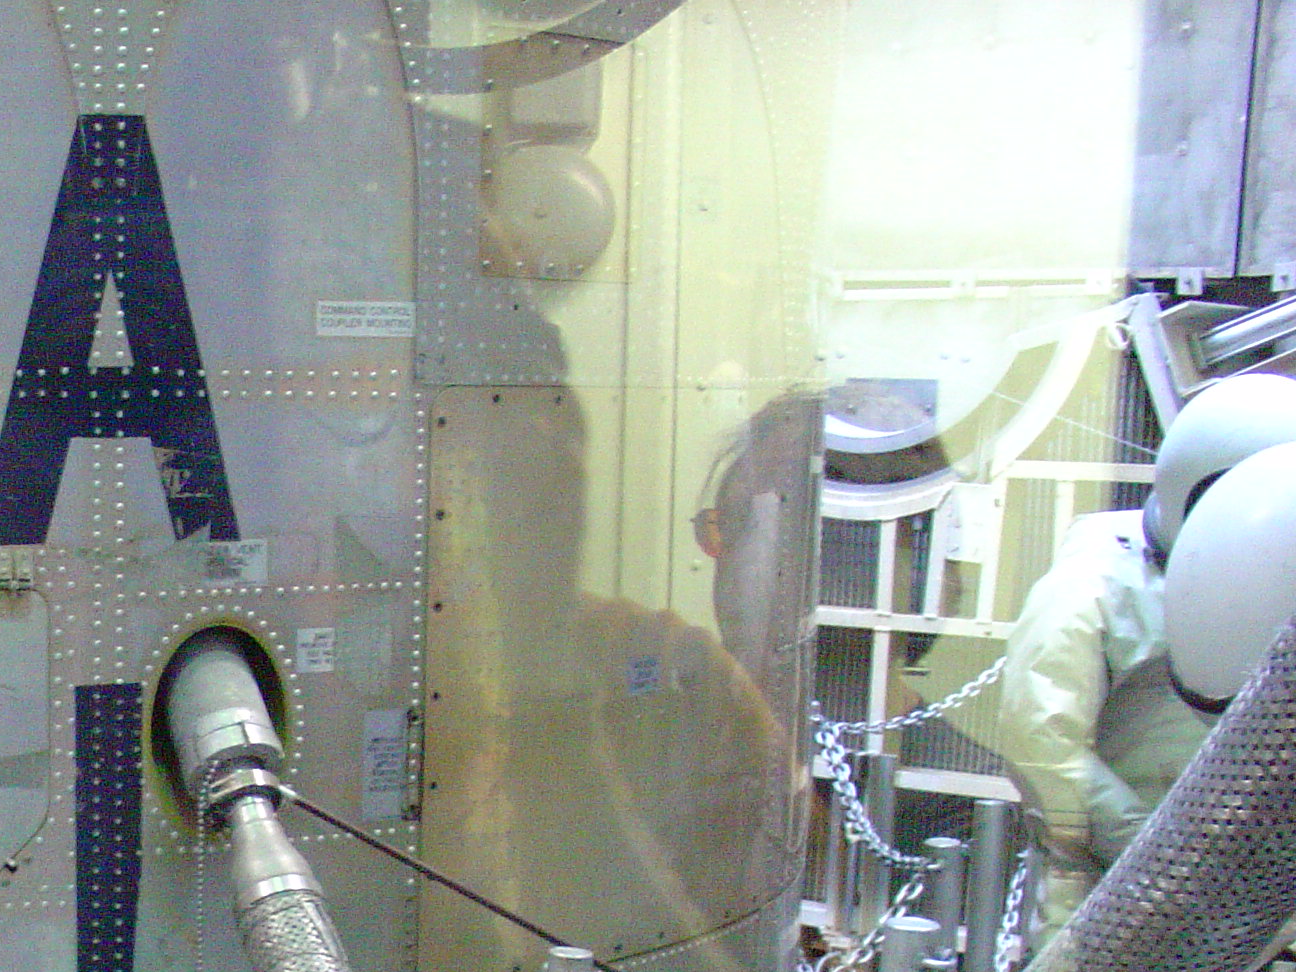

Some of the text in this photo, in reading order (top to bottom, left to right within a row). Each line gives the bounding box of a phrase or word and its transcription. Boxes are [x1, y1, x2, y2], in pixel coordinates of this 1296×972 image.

[320, 305, 410, 316] COMMAND CONTROL
[320, 318, 412, 328] COUPLER MOUNTING
